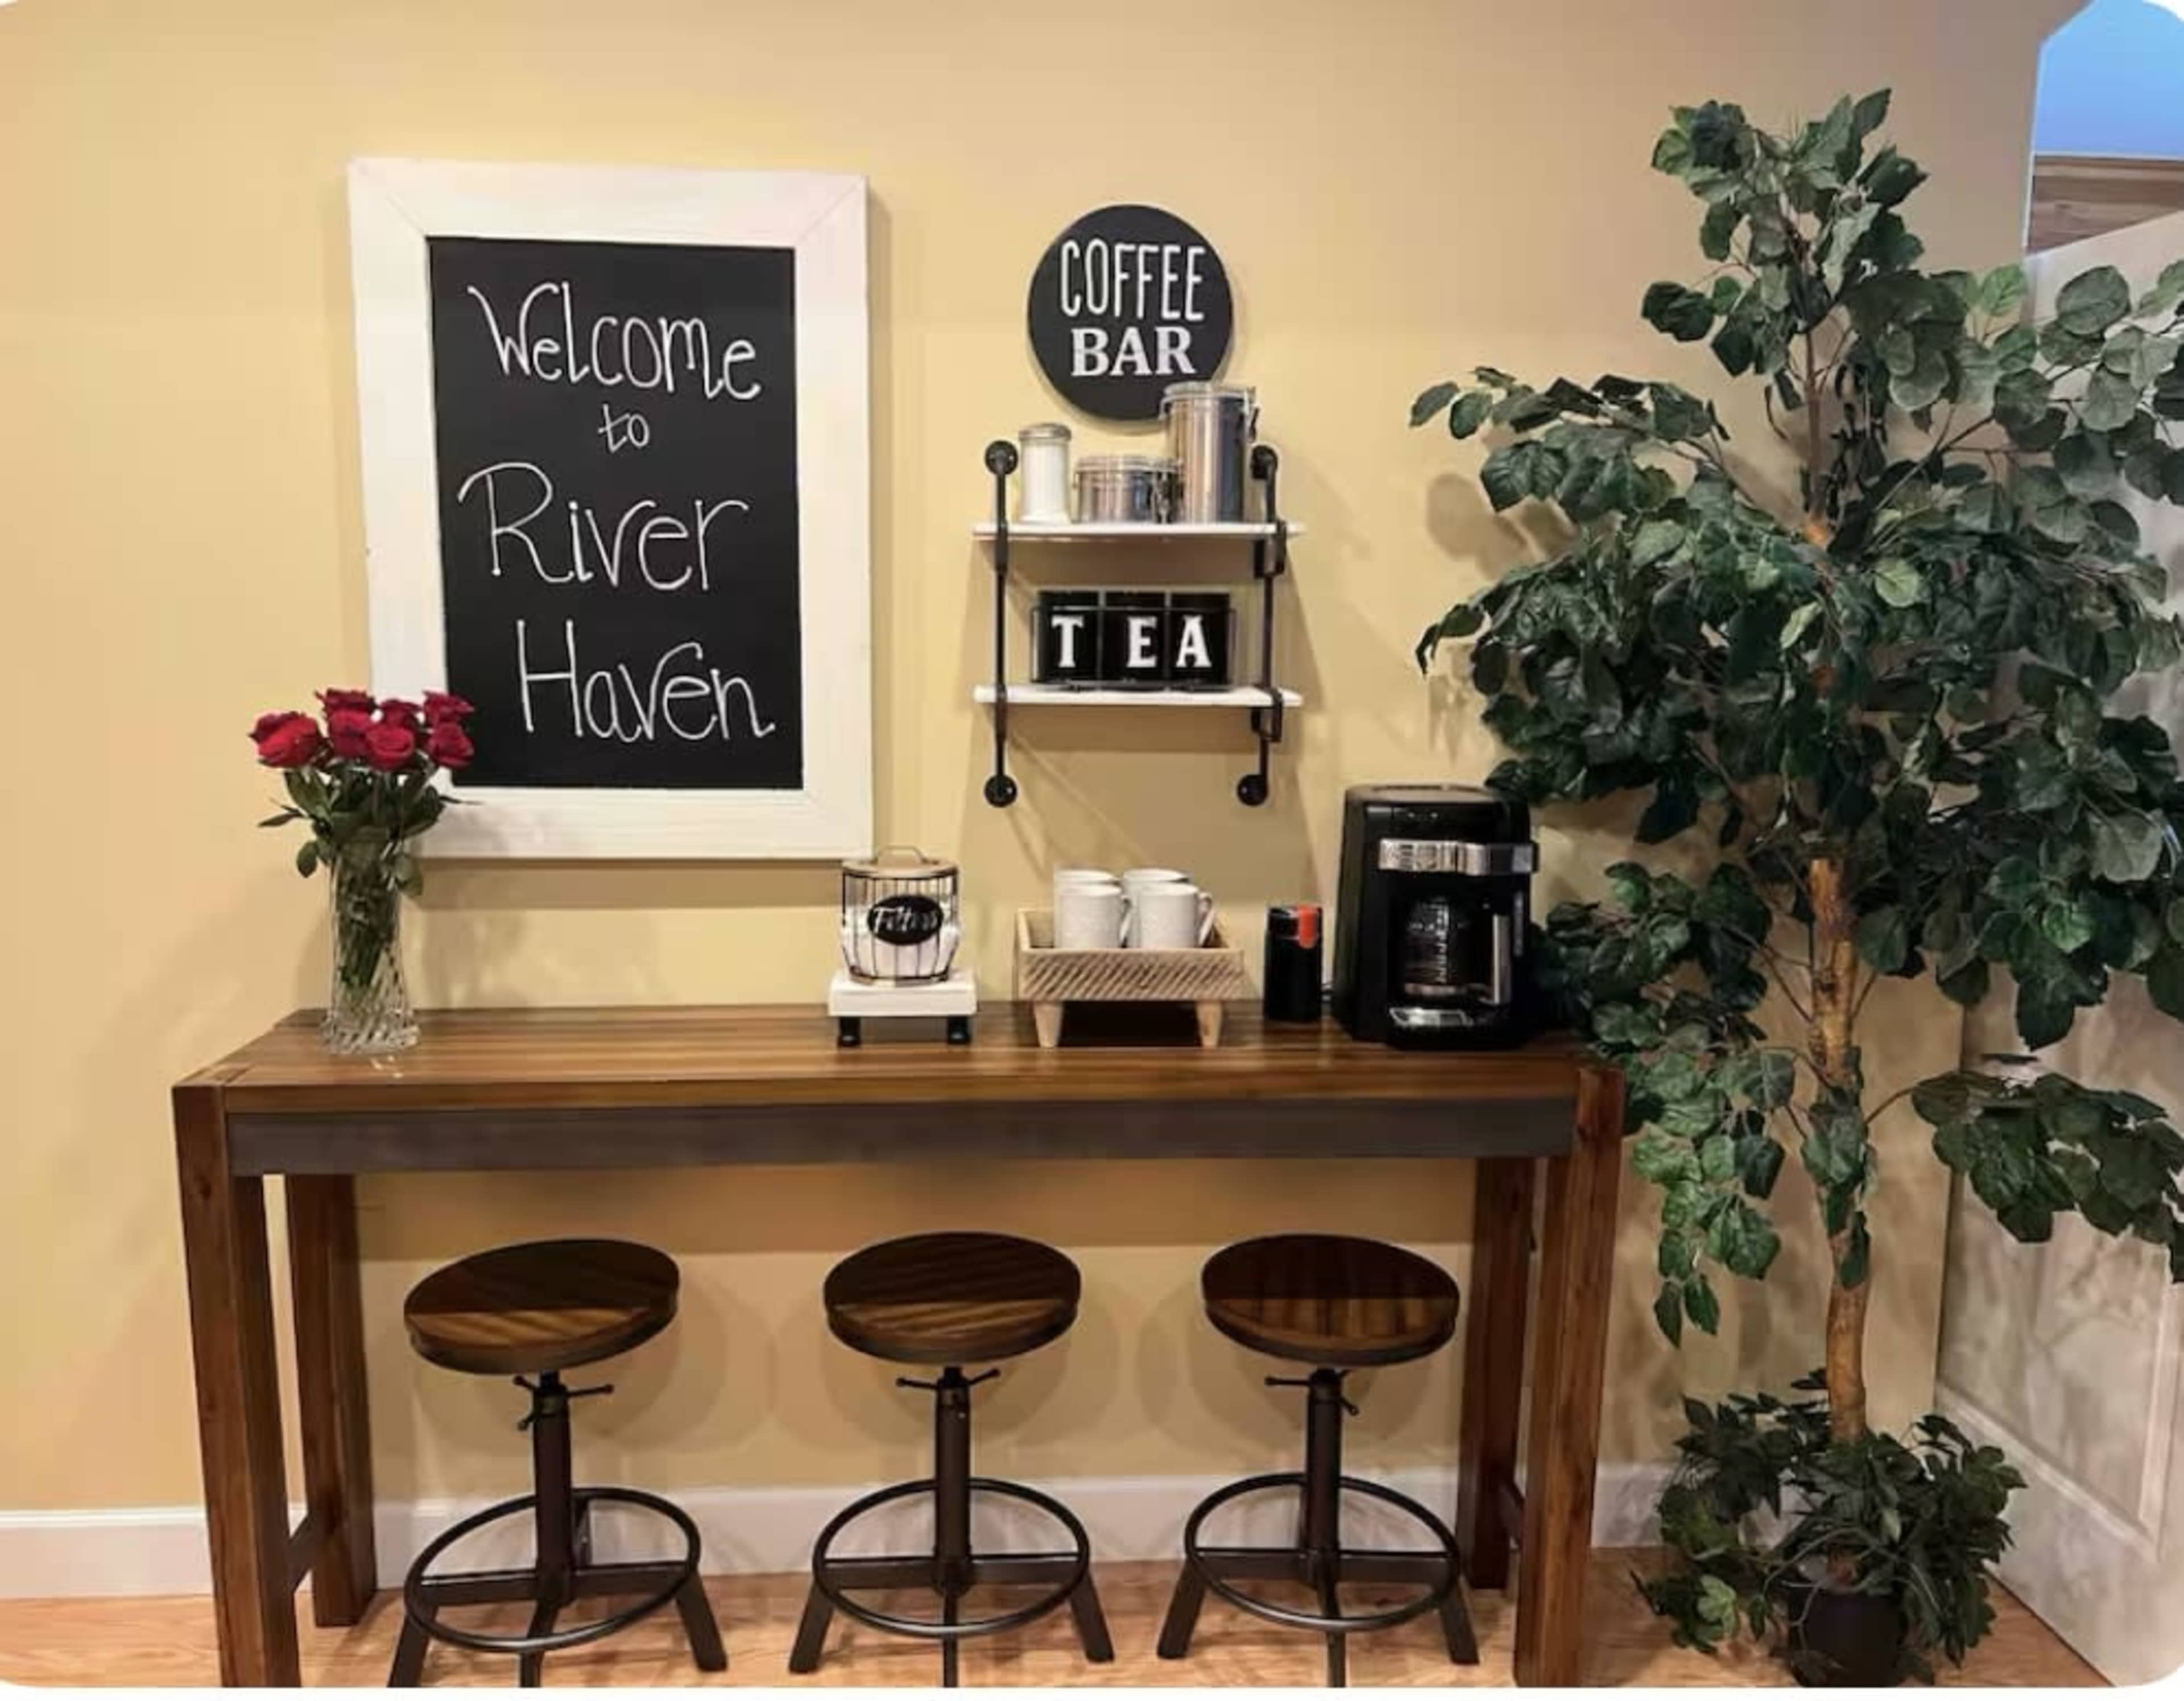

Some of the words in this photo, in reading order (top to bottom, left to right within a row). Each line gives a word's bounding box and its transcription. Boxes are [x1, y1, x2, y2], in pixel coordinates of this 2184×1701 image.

[1061, 238, 1205, 320] COFFEE
[466, 281, 762, 400] Welcome
[1072, 326, 1196, 376] BAR
[597, 403, 650, 453] to
[457, 461, 750, 591] River
[516, 619, 776, 743] Haven
[1051, 615, 1212, 668] TEA
